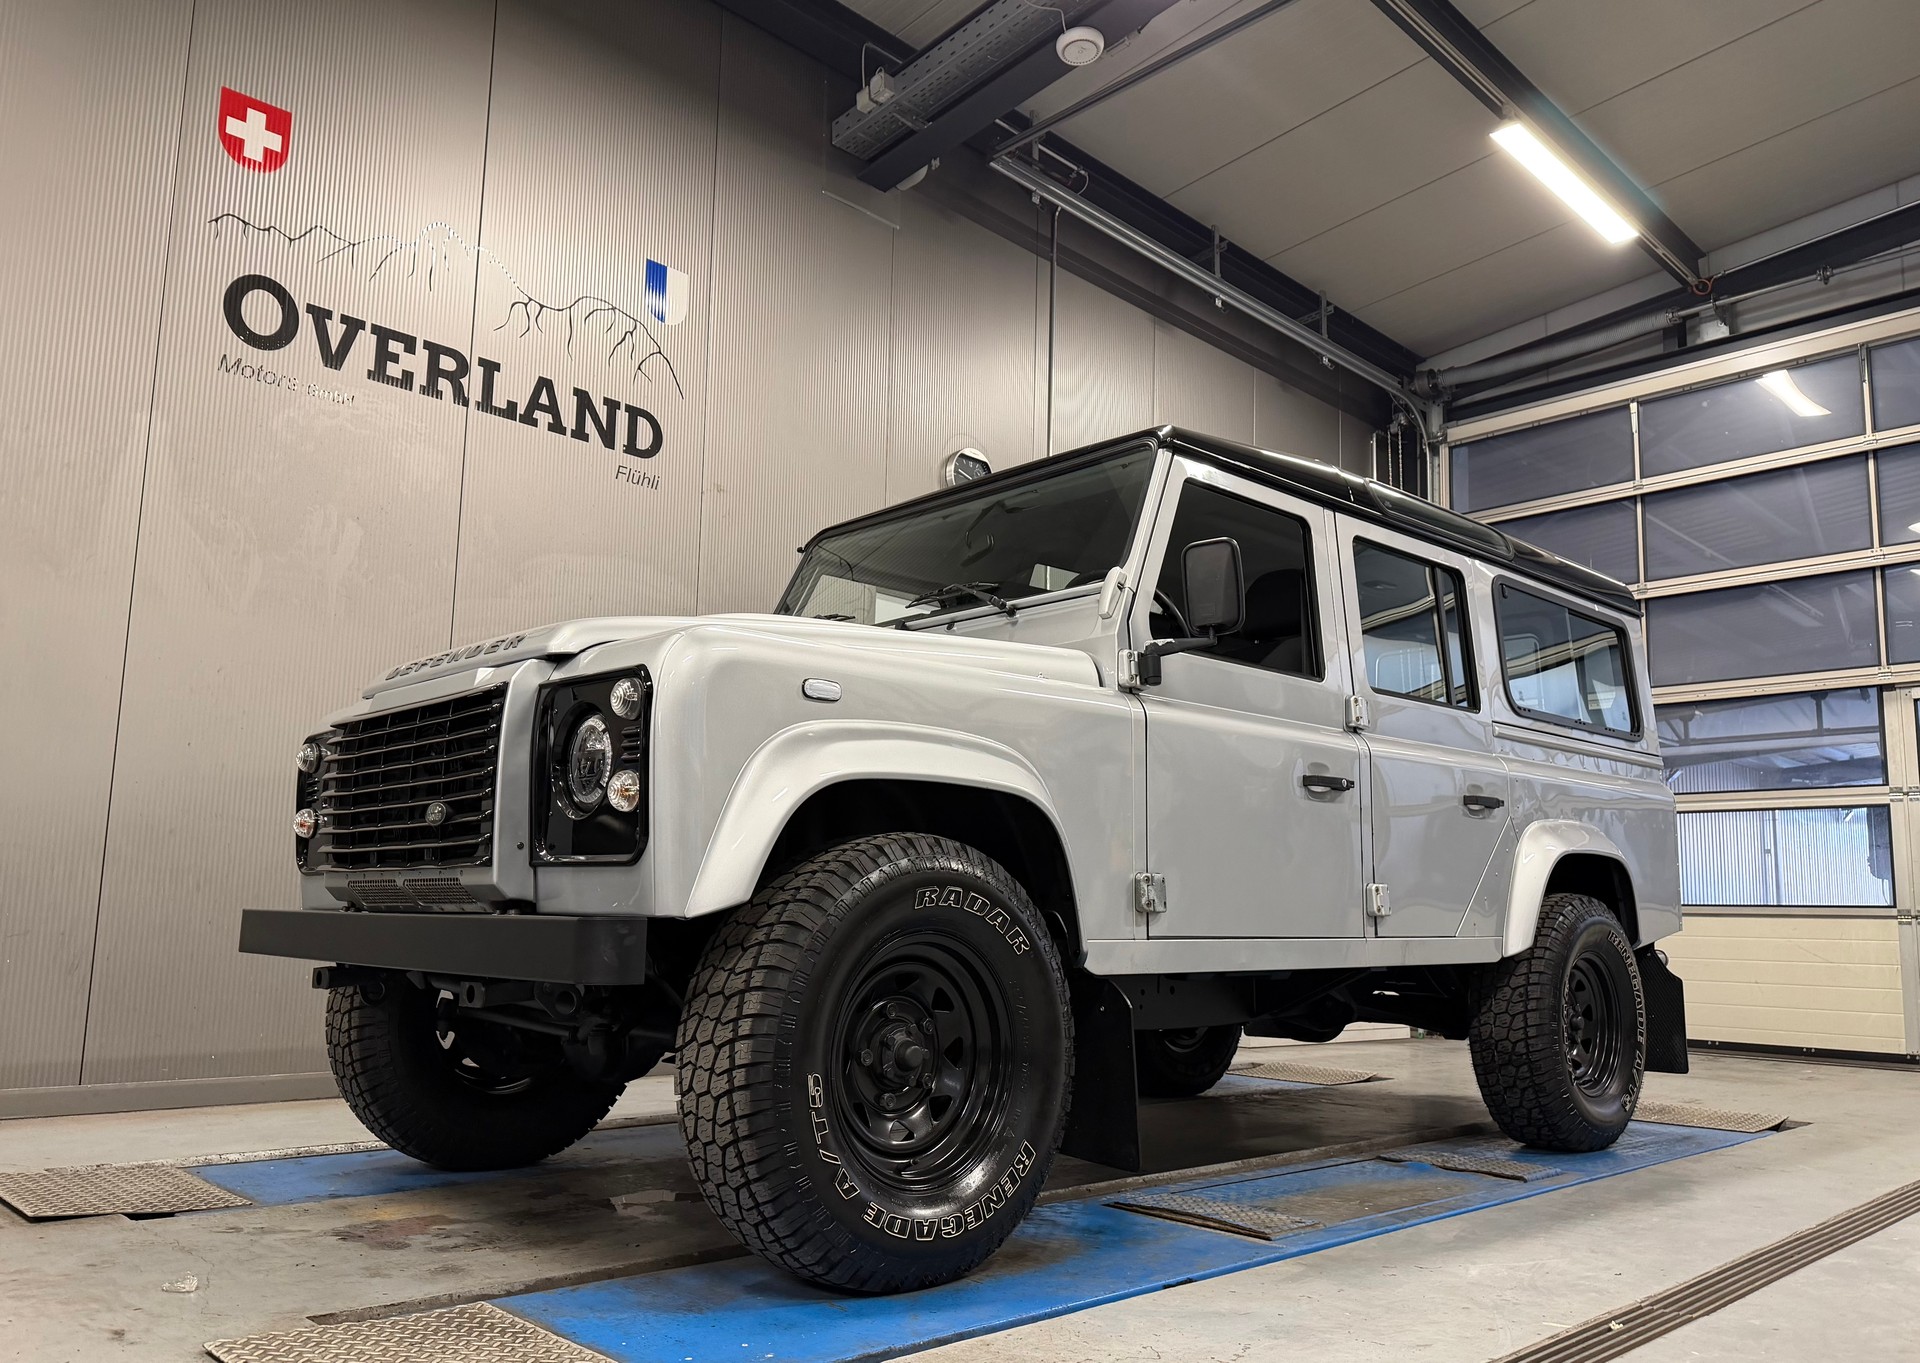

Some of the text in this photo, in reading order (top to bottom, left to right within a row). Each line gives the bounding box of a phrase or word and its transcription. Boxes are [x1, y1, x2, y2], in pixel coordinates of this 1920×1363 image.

[217, 354, 298, 391] Motors
[223, 274, 664, 459] OVERLAND
[615, 465, 660, 490] Flühli
[385, 634, 528, 681] DEFENDER
[914, 886, 1030, 955] RADAR
[1608, 930, 1646, 1046] RENEGADE
[862, 1140, 1037, 1241] RENEGADE
